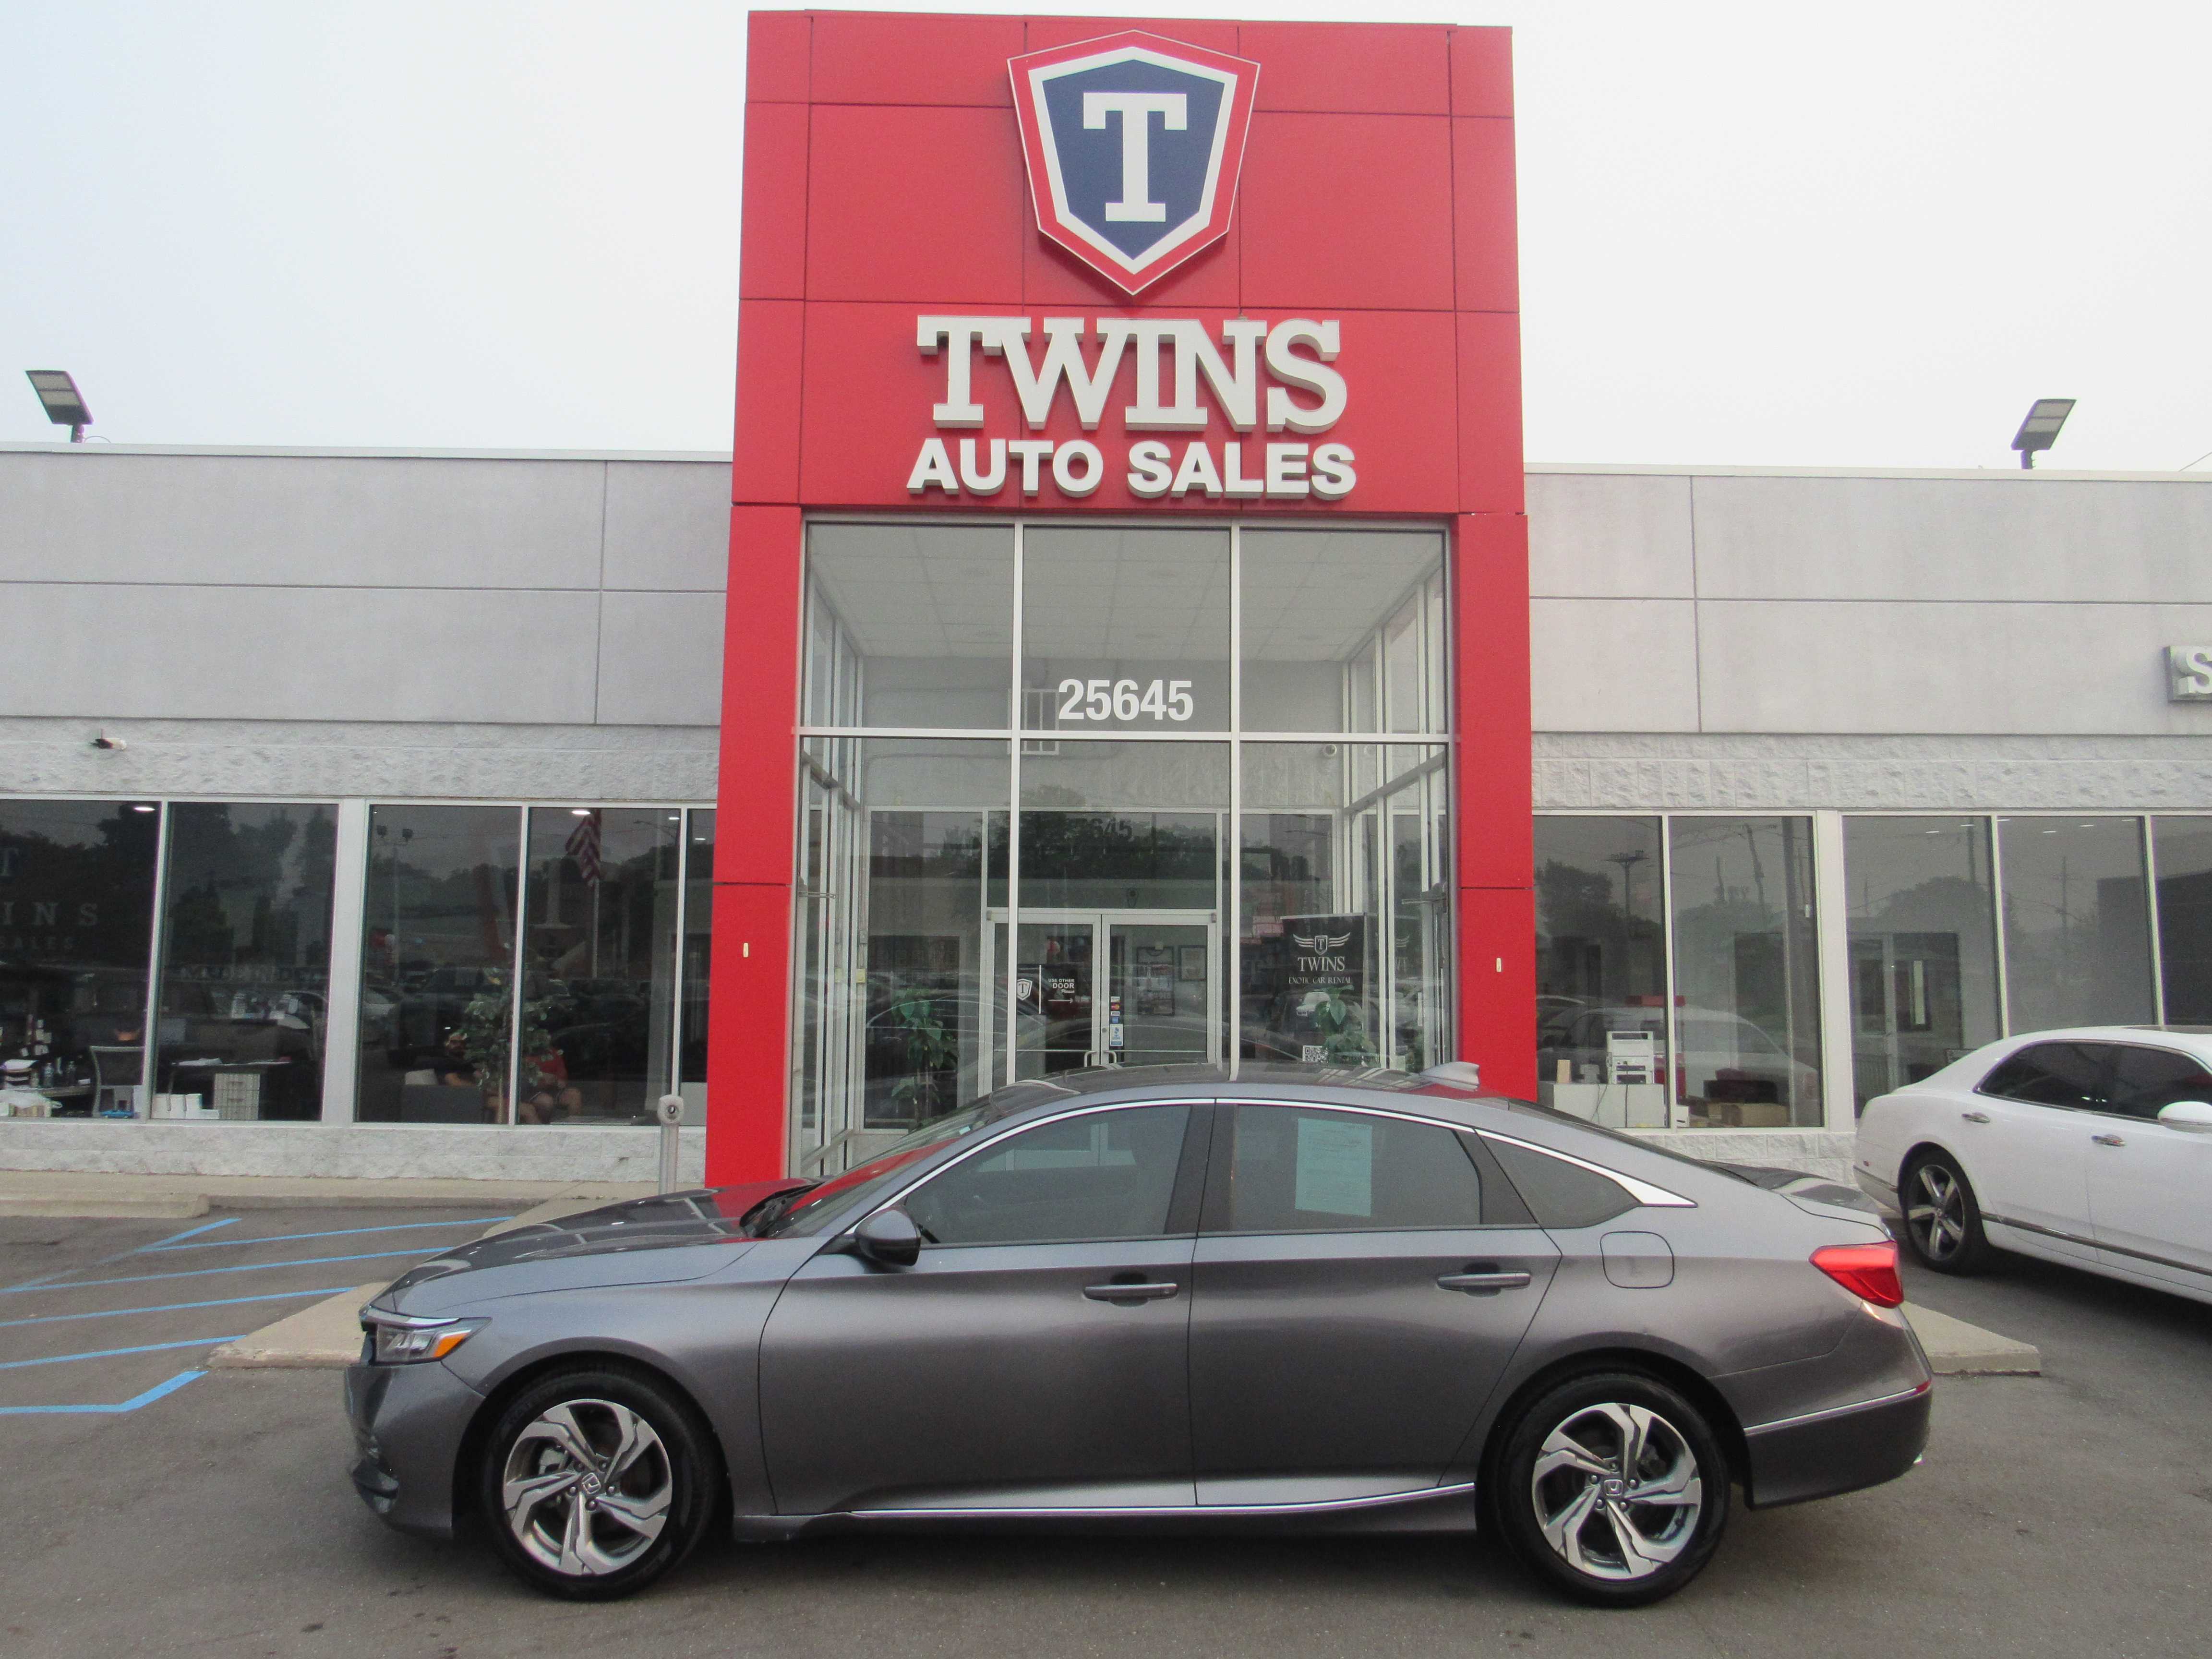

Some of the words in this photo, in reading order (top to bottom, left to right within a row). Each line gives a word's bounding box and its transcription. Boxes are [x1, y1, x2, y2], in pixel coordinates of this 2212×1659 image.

[1083, 92, 1187, 222] T
[916, 315, 1347, 434] TWINS
[906, 438, 1104, 498] AUTO
[1127, 440, 1357, 501] SALES
[1058, 679, 1194, 721] 25645
[1298, 956, 1345, 972] TWINS
[1317, 938, 1325, 950] T
[1018, 983, 1028, 993] T
